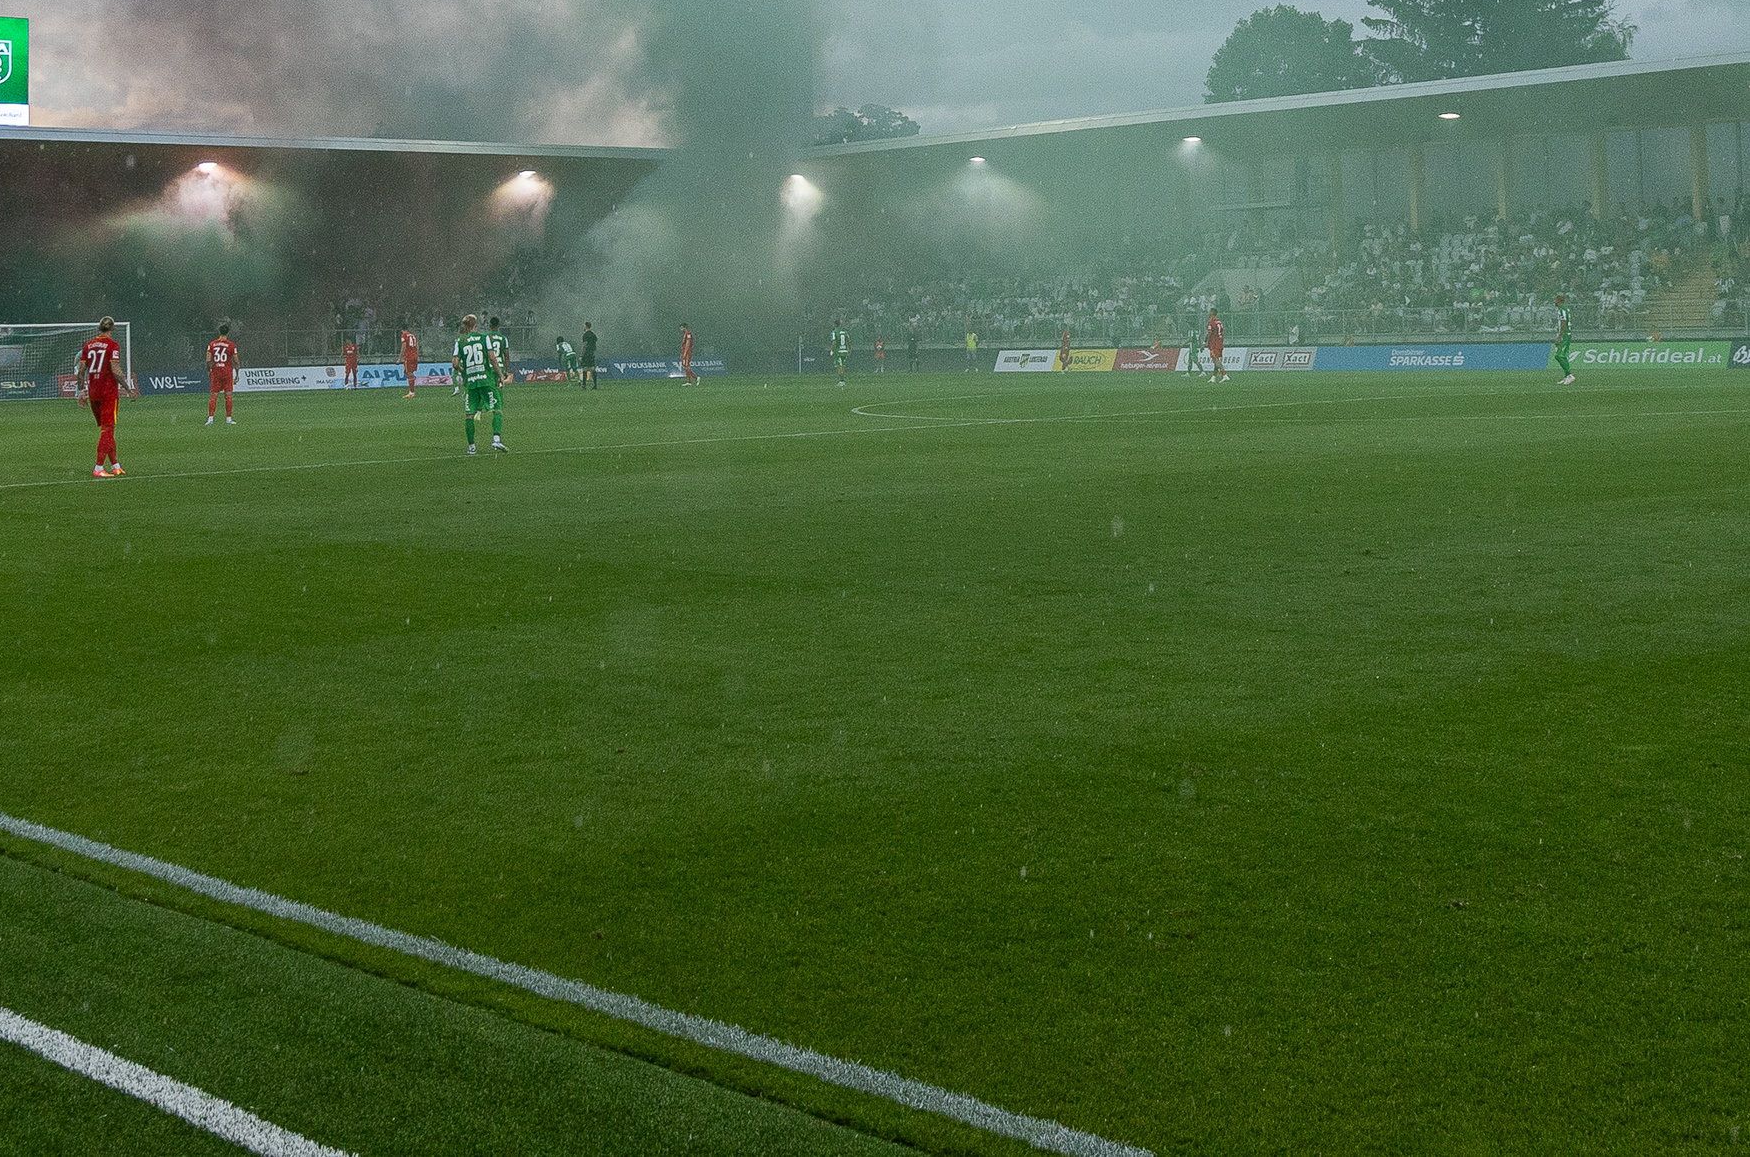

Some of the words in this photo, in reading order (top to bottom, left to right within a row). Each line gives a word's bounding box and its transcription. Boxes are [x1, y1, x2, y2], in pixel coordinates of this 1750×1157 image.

[213, 346, 227, 363] 36
[463, 343, 484, 367] 26
[1073, 355, 1102, 365] RAUCH
[1252, 351, 1274, 363] Xact
[1285, 351, 1308, 363] Xact
[1389, 355, 1452, 366] SPARKASSE
[1582, 347, 1722, 364] Schlafideal.at
[87, 349, 106, 374] 27
[244, 370, 275, 378] UNITED
[0, 380, 36, 389] SUN
[247, 377, 301, 386] ENGINEERING
